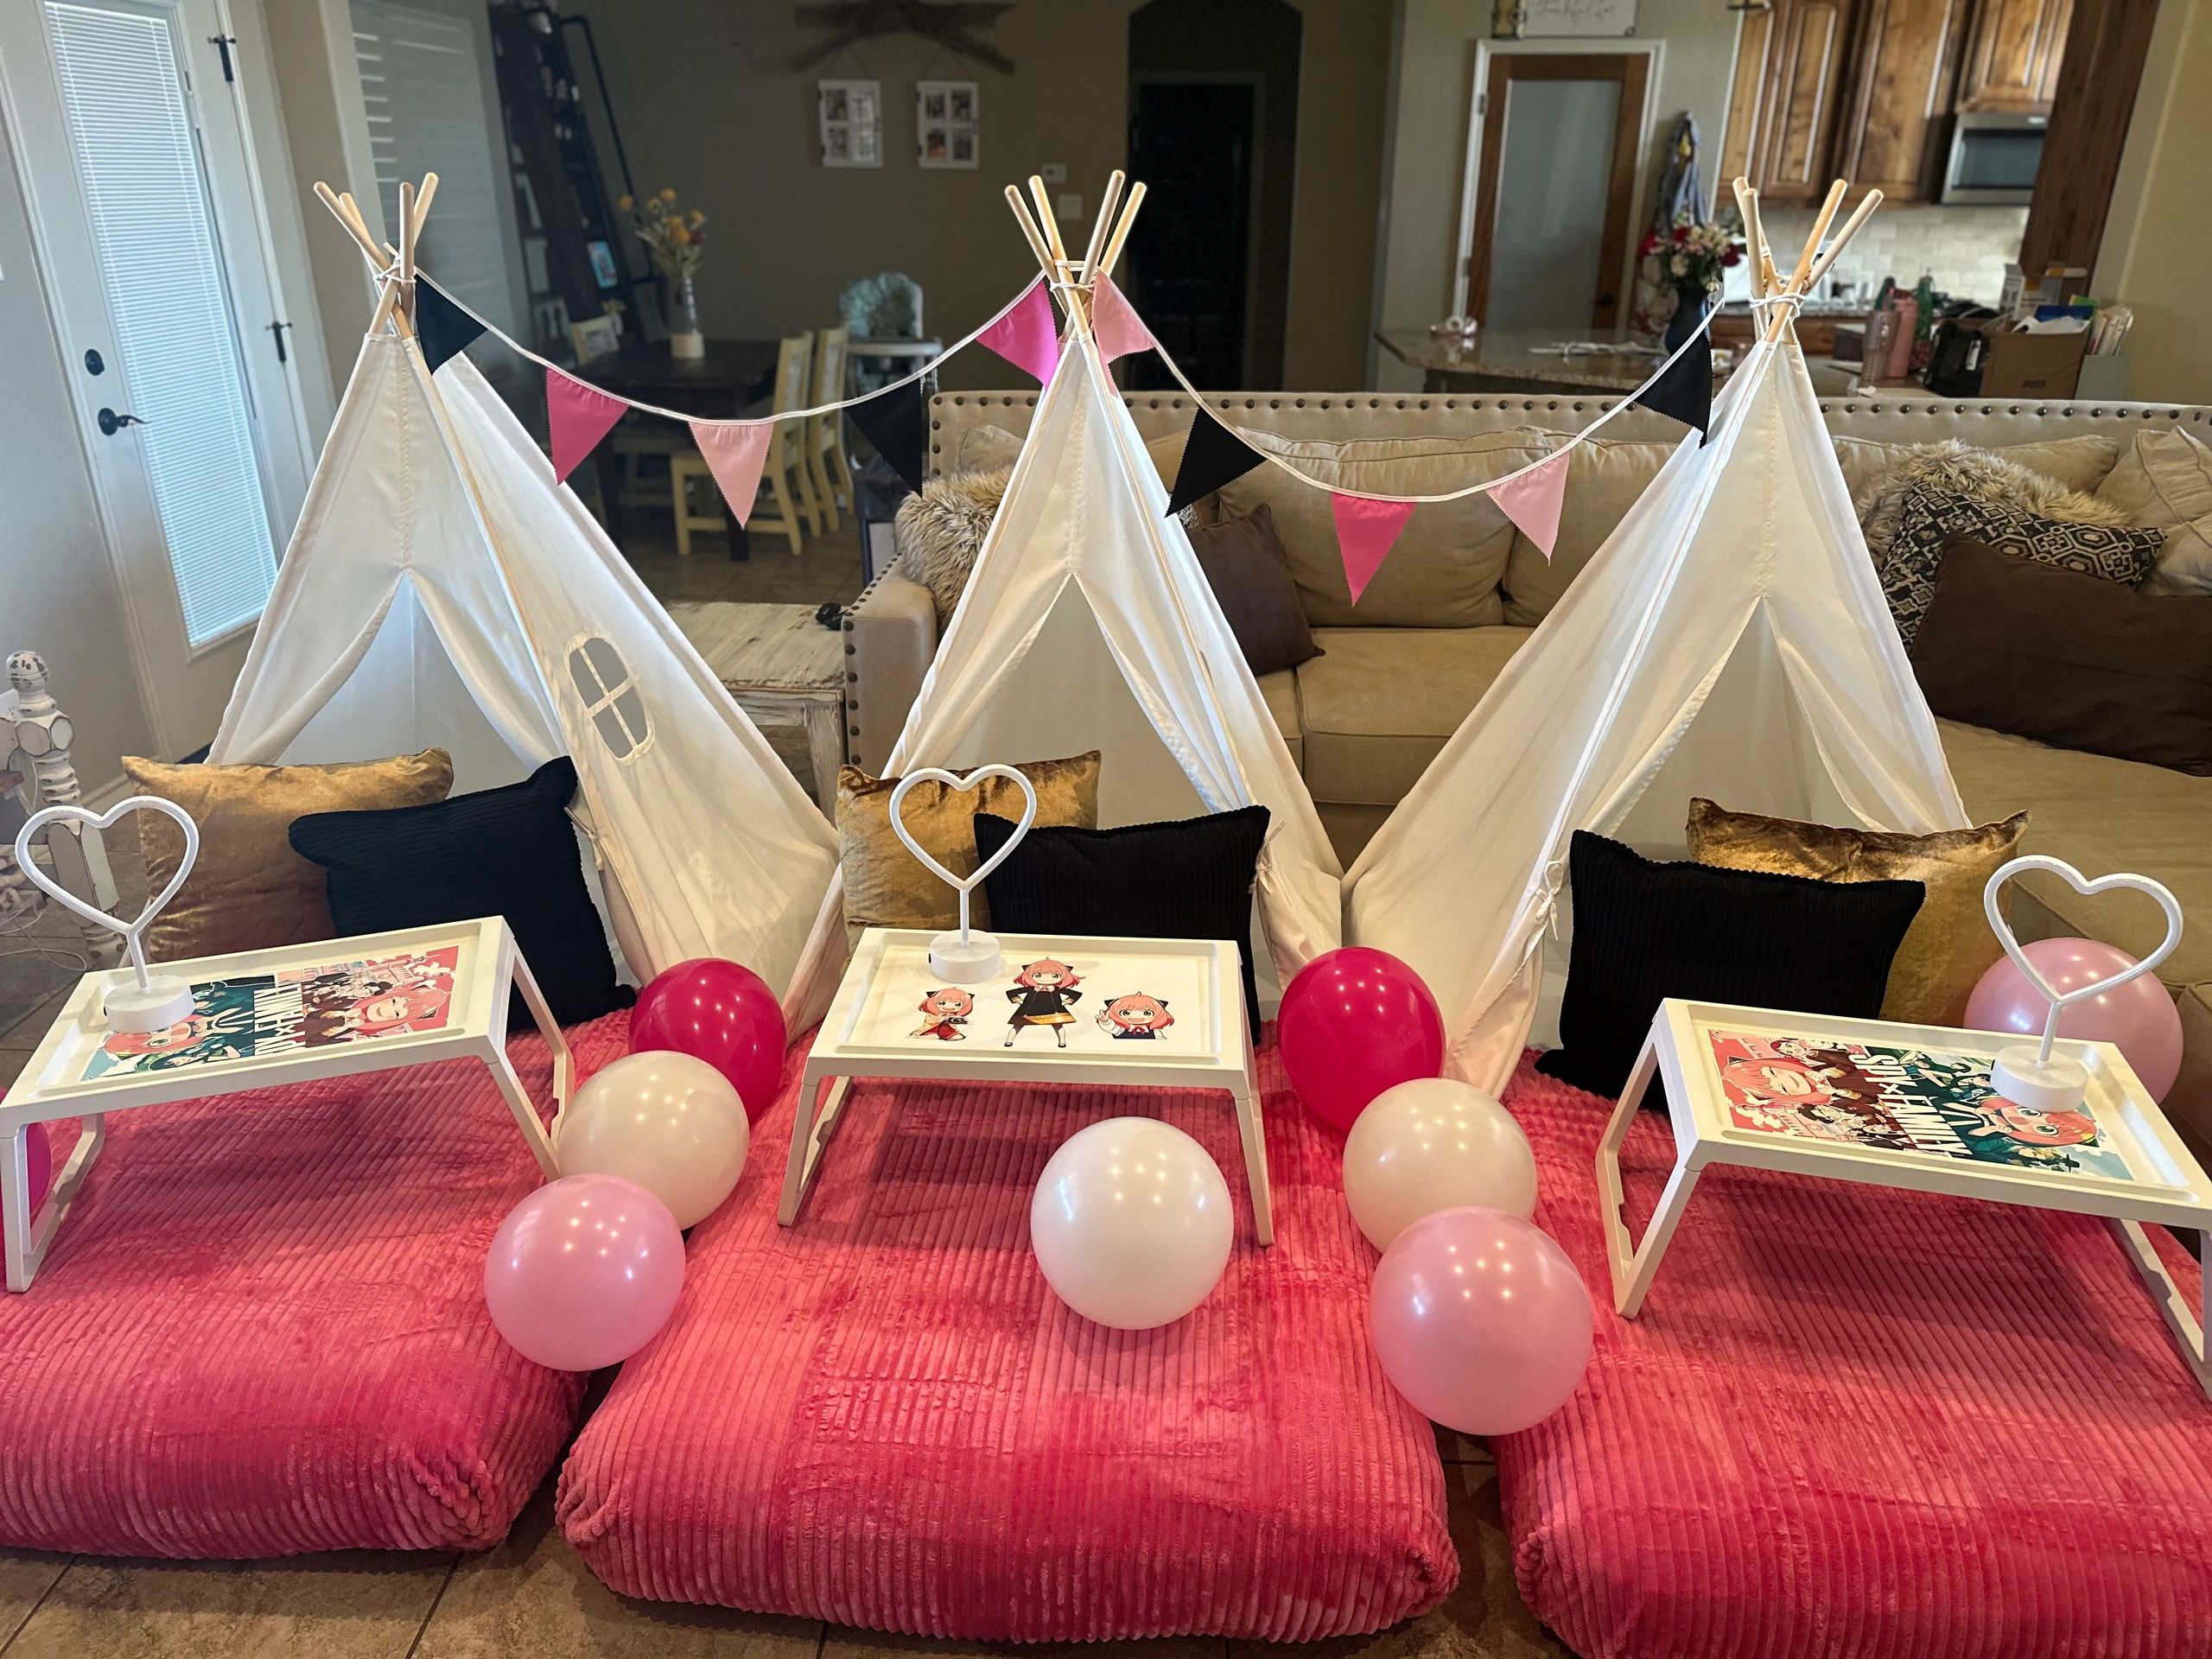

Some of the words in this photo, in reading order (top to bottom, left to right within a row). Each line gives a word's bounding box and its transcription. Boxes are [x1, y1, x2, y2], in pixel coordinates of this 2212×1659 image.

[253, 982, 304, 1033] FAMILY
[254, 1031, 306, 1056] PY
[1847, 1054, 1917, 1087] SPY
[1876, 1093, 1974, 1155] FAMILY
